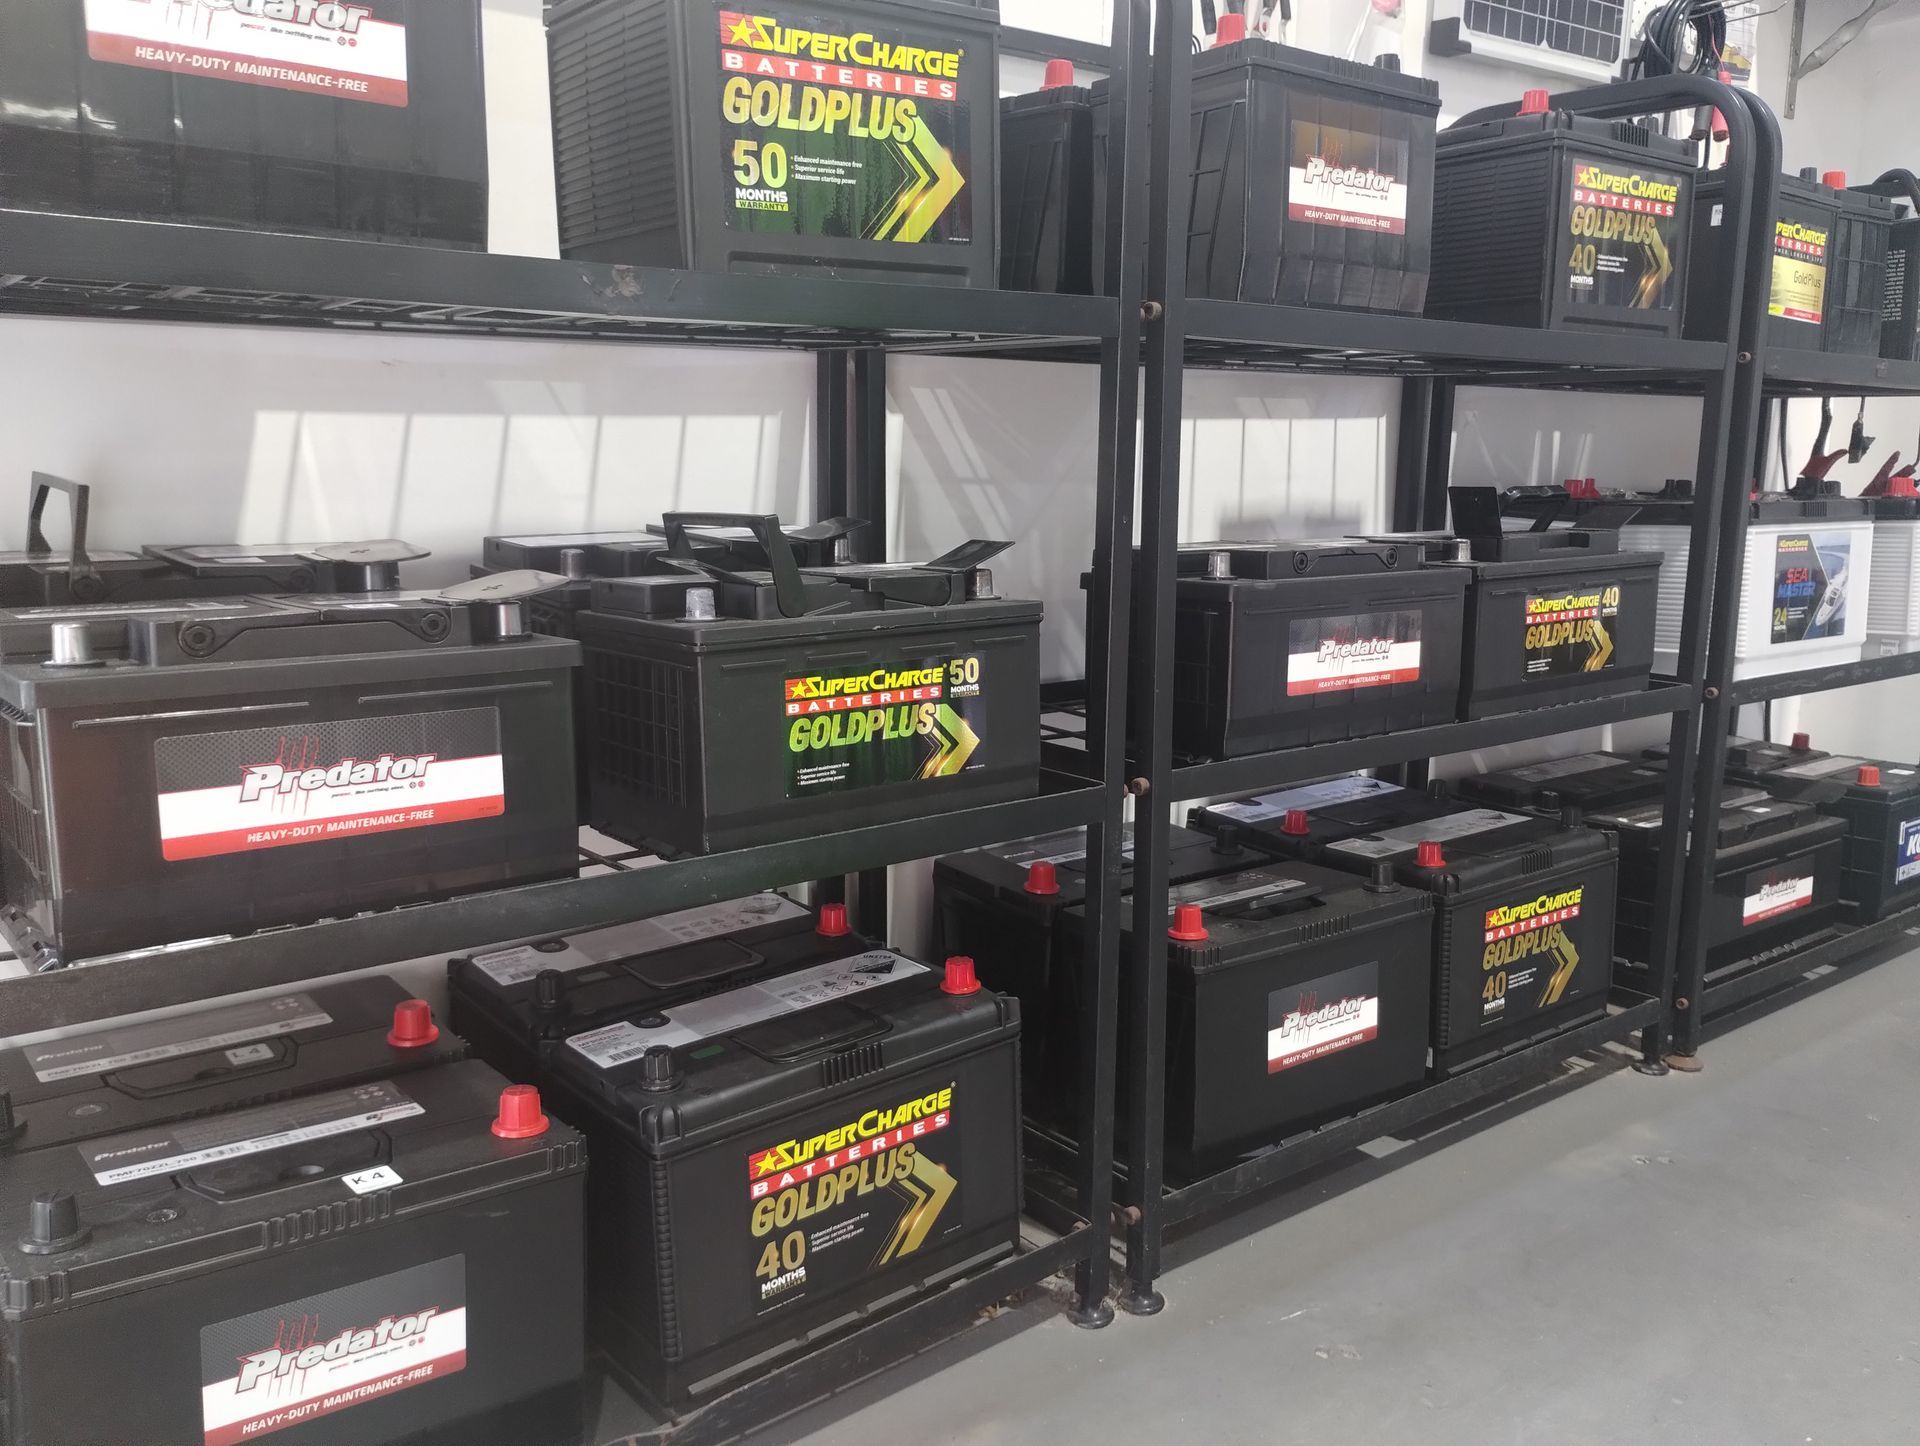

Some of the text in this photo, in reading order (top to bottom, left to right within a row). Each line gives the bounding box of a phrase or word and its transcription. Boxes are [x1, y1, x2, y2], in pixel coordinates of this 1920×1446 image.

[135, 45, 369, 93] HEAVY-DUTY MAINTENANCE-FREE
[725, 52, 954, 98] BATTERIES
[722, 76, 917, 143] GOLDPLUS
[733, 139, 788, 189] 50
[1304, 155, 1394, 193] Predator
[735, 187, 788, 203] MONTHS
[738, 201, 786, 211] WARRANTY
[1574, 190, 1673, 215] BATTERIES
[1304, 209, 1391, 229] HEAVY-DUTY MAINTENANCE-FREE
[1570, 205, 1656, 245] GOLDPLUS
[1775, 221, 1826, 246] PERCHARGE
[1568, 243, 1596, 275] 40
[1775, 235, 1822, 255] TERIES
[1570, 274, 1594, 285] MONTHS
[1794, 270, 1821, 288] GoldPlus
[1785, 568, 1808, 584] SEA
[1602, 587, 1619, 607] 40
[1526, 608, 1597, 624] BATTERIES
[1774, 607, 1787, 625] 24
[1525, 618, 1594, 650] GOLDPLUS
[1317, 638, 1394, 663] Predator
[950, 657, 980, 685] 50
[1317, 678, 1348, 689] HEAVY-DUTY
[788, 687, 940, 714] BATTERIES
[950, 683, 980, 692] MONTHS
[789, 702, 936, 752] GOLDPLUS
[239, 753, 437, 803] Predator
[247, 808, 435, 844] HEAVY-DUTY MAINTENANCE-FREE
[1485, 906, 1579, 941] BATTERIES
[1482, 923, 1562, 971] GOLDPLUS
[1482, 971, 1507, 1001] 40
[1280, 996, 1366, 1039] Predator
[1484, 997, 1505, 1010] MONTHS
[1282, 1033, 1363, 1066] HEAVY-DUTY MAINTENANCE-FREE
[94, 1140, 171, 1162] Predator
[752, 1113, 948, 1196] BATTERIES
[352, 1171, 385, 1185] K 4
[751, 1142, 916, 1237] GOLDPLUS
[755, 1230, 806, 1279] 40
[761, 1266, 806, 1293] MONTHS
[235, 1306, 438, 1395] Predator
[242, 1364, 433, 1435] HEAVY-DUTY MAINTENANCE-FREE
